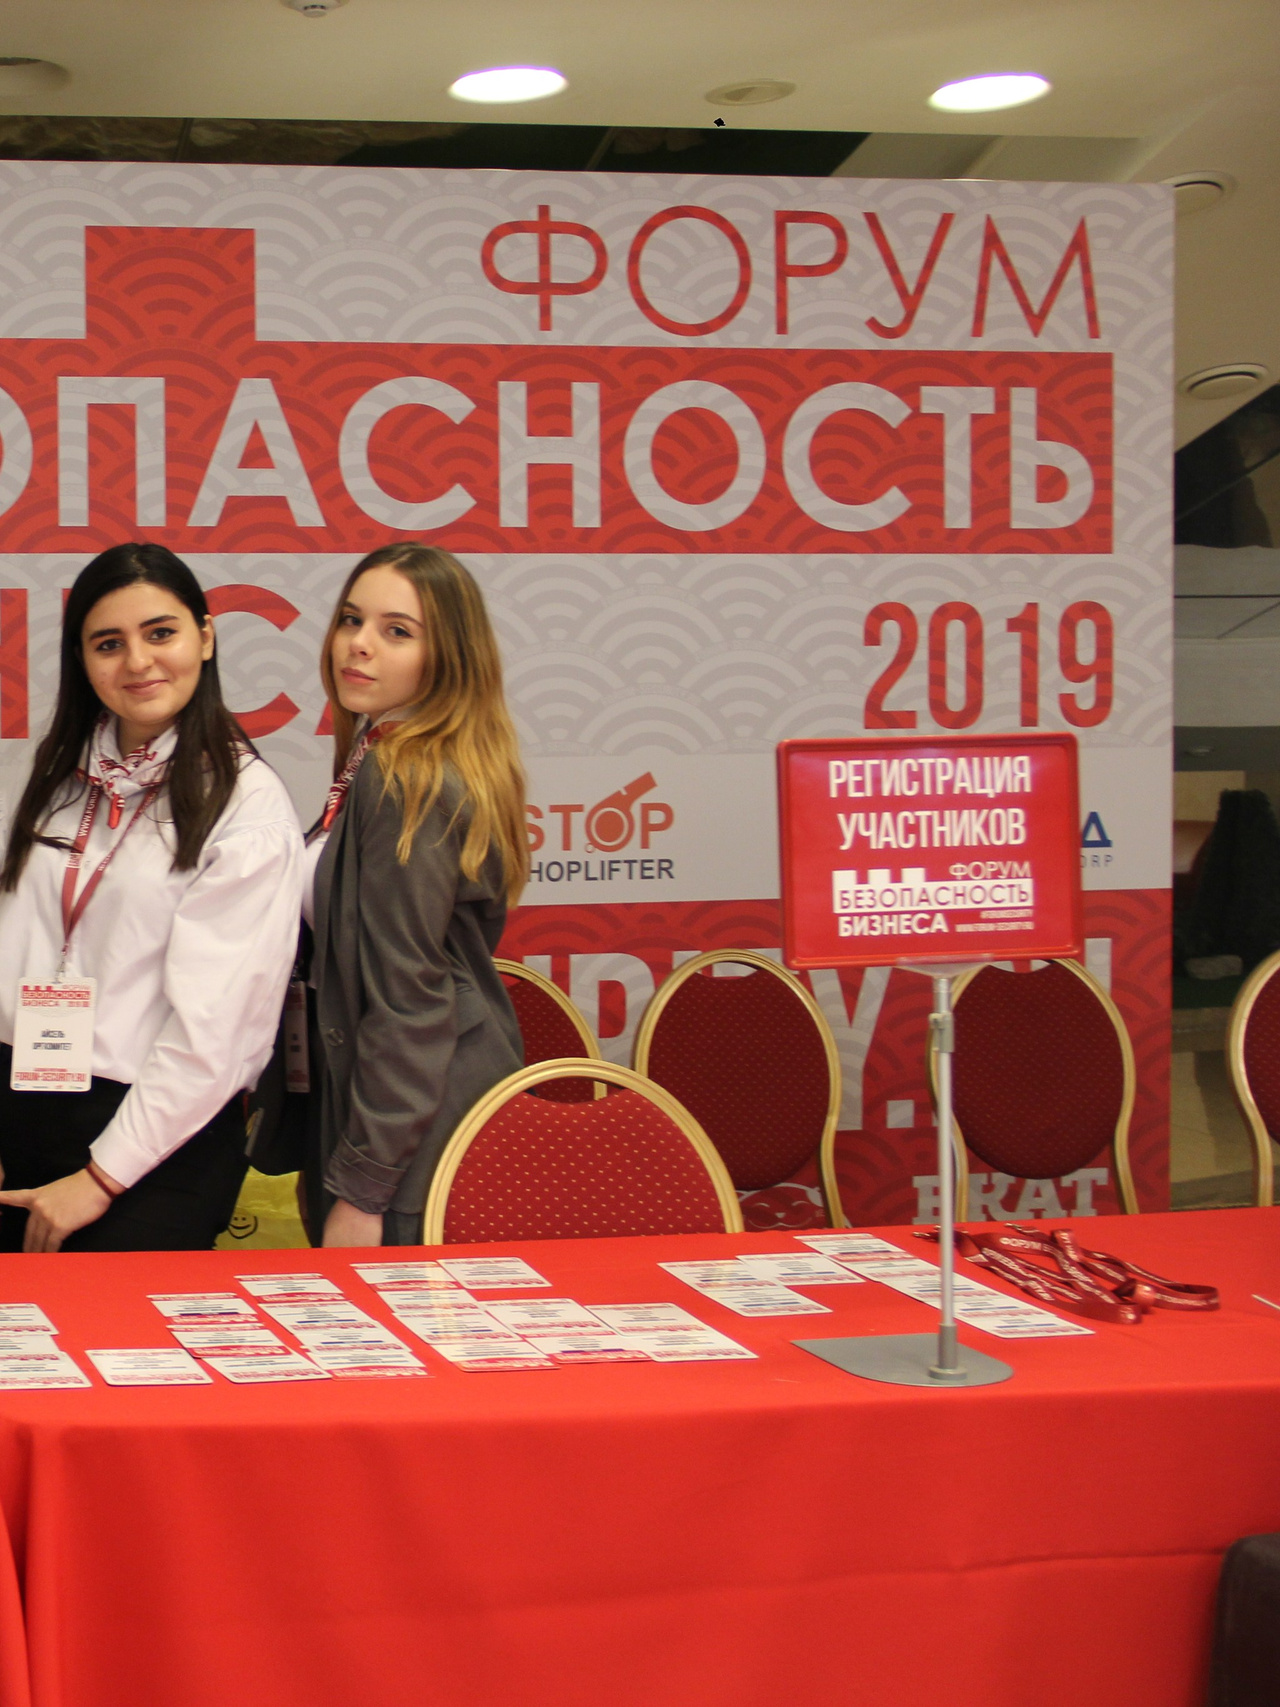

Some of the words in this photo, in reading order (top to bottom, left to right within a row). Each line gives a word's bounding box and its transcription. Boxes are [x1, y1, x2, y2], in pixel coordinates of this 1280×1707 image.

[480, 204, 1102, 340] ФОРУМ
[862, 600, 1114, 730] 2019
[828, 756, 1032, 798] РЕГИСТРАЦИЯ
[837, 808, 1027, 850] УЧАСТНИКОВ
[528, 858, 675, 883] HOPLIFTER
[949, 861, 1031, 880] ФОРУМ
[839, 884, 1029, 910] БЕЗОПАСНОСТЬ
[838, 913, 949, 937] БИЗНЕСА
